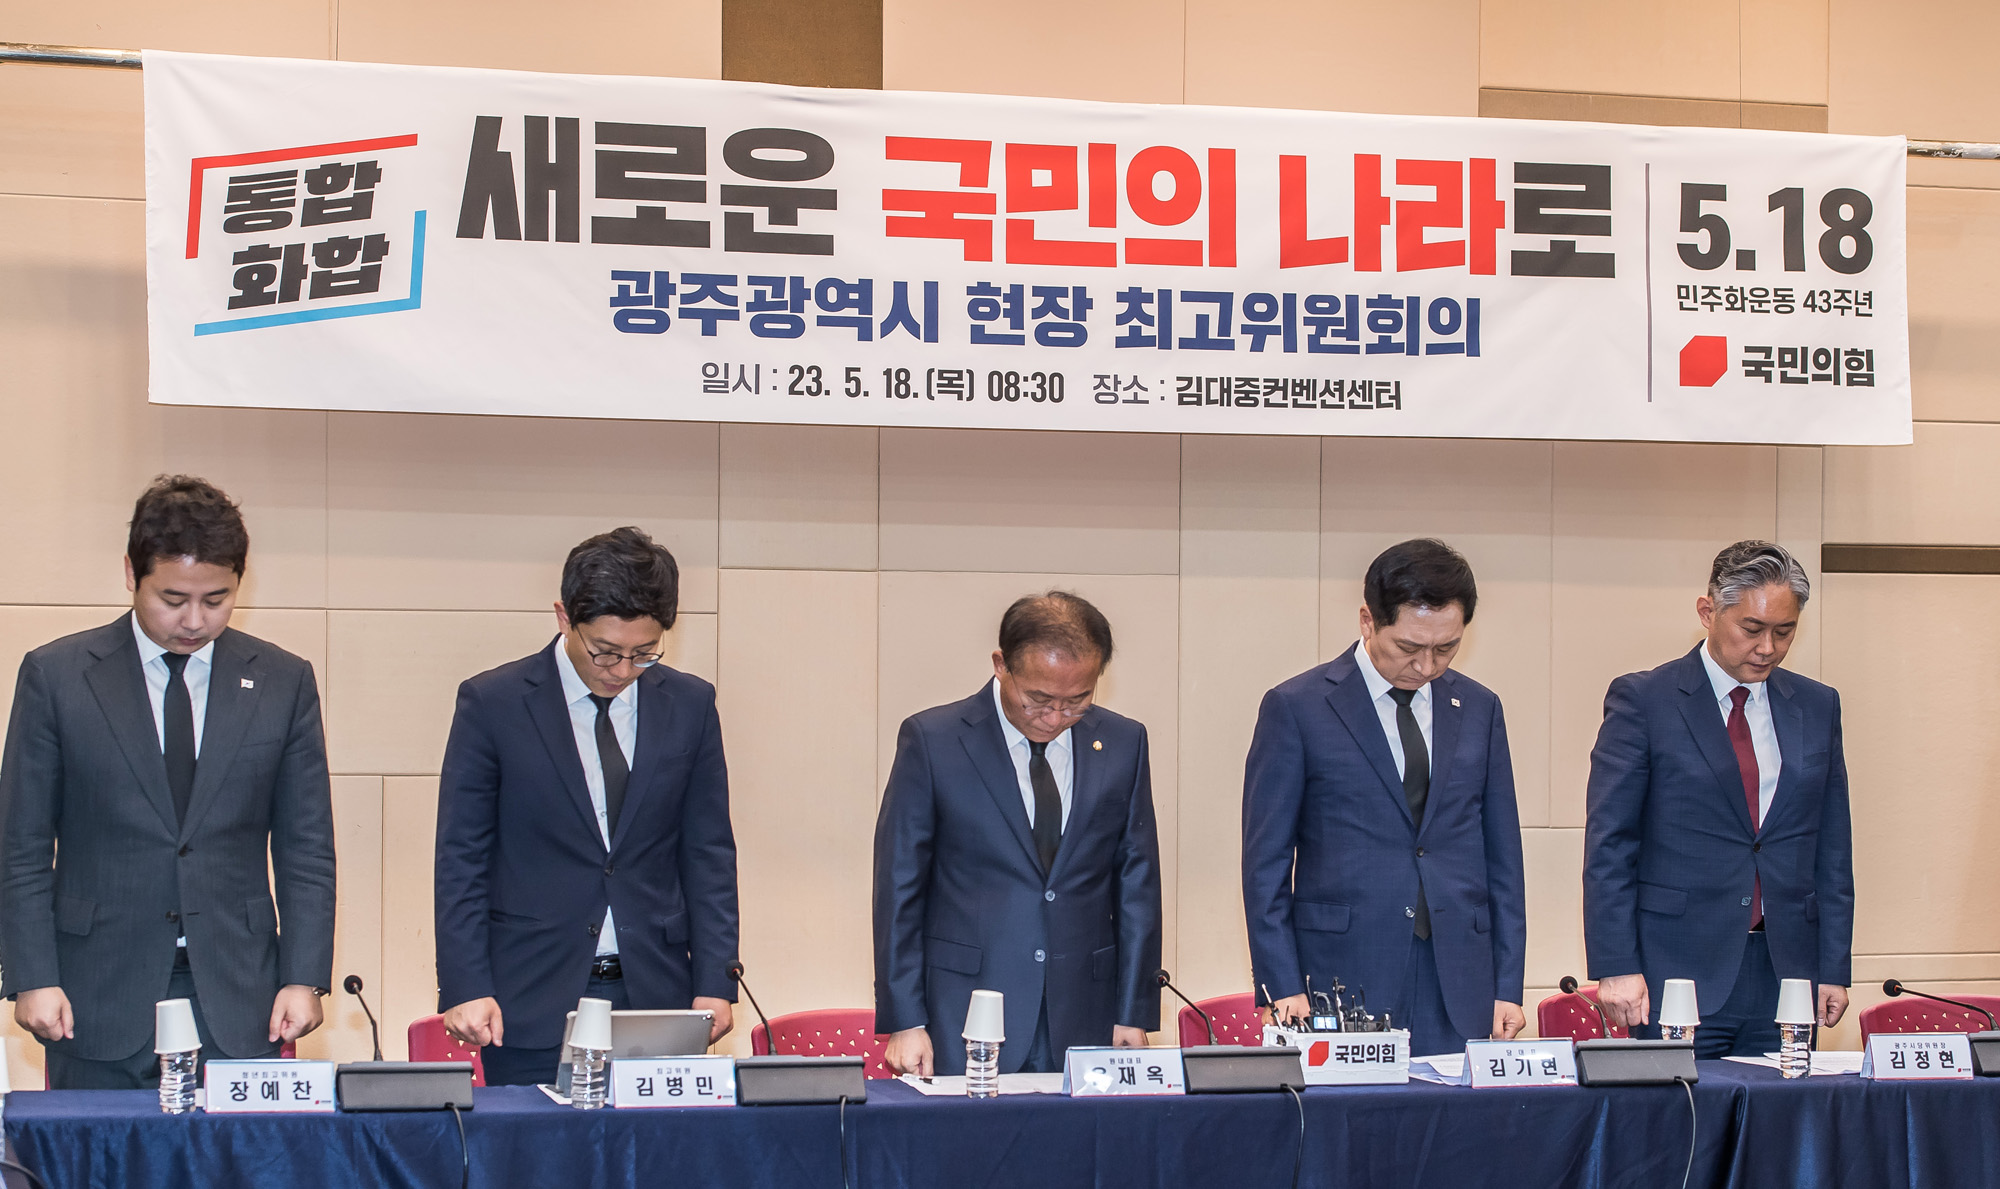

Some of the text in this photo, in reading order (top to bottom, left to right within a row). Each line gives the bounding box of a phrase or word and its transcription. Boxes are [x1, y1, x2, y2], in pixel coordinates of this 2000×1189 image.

[222, 158, 382, 235] 통합
[456, 115, 1616, 278] 새로운 국민의 나라로
[1676, 182, 1874, 274] 5.18
[227, 232, 389, 311] 화합
[609, 270, 1481, 357] 광주광역시 현장 최고위원회의
[1676, 284, 1874, 318] 민주화운동 43주년
[788, 364, 831, 397] 23.
[844, 366, 870, 398] 5.
[987, 370, 1065, 404] 08:30
[1741, 345, 1875, 388] 국민의힘
[1175, 376, 1402, 411] 김대중컨벤션센터
[1335, 1043, 1396, 1064] 국민의힘
[1489, 1057, 1558, 1078] 김기현
[1889, 1050, 1955, 1070] 김정현
[230, 1080, 312, 1102] 장예찬
[636, 1076, 713, 1097] 김병민
